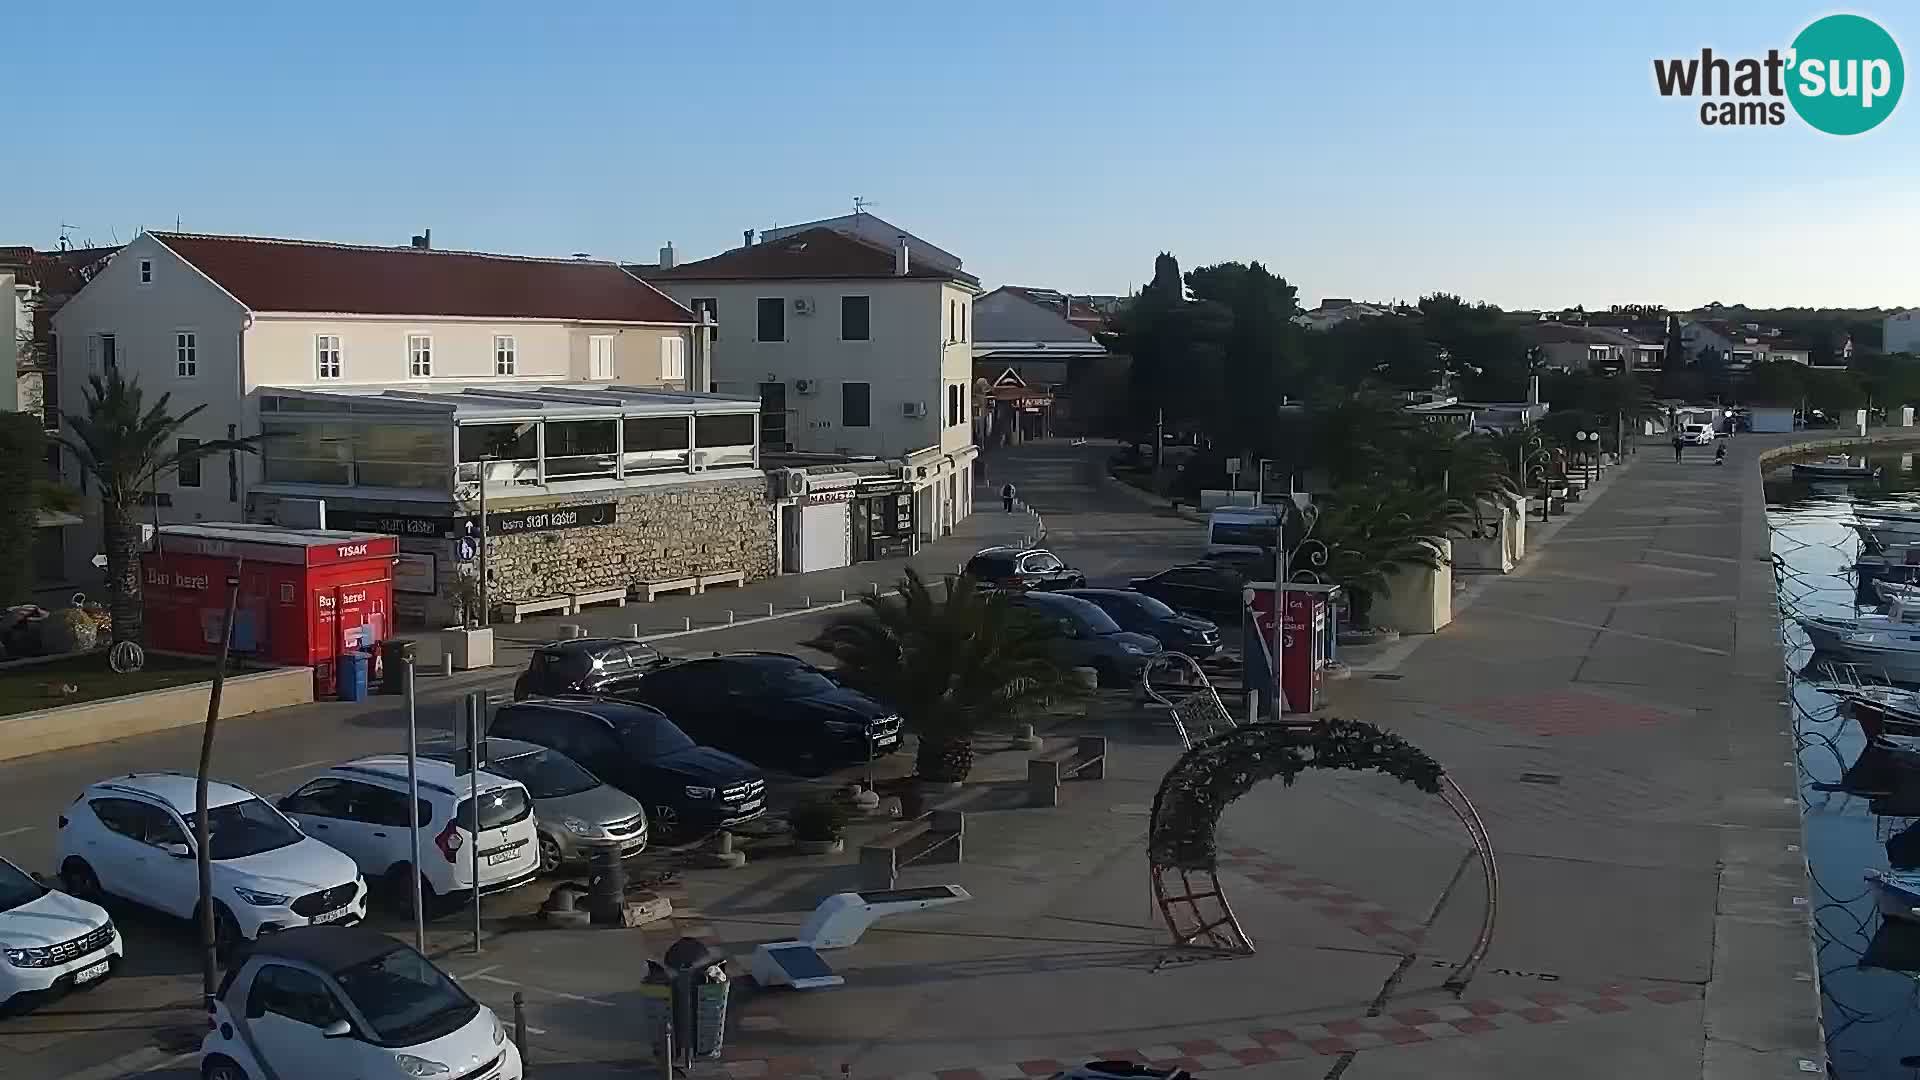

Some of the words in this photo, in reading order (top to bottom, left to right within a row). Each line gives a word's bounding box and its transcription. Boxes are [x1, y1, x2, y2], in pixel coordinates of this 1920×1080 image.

[502, 519, 524, 530] bistro
[338, 544, 368, 557] TISAK
[319, 595, 336, 609] Buy
[343, 589, 366, 604] here!
